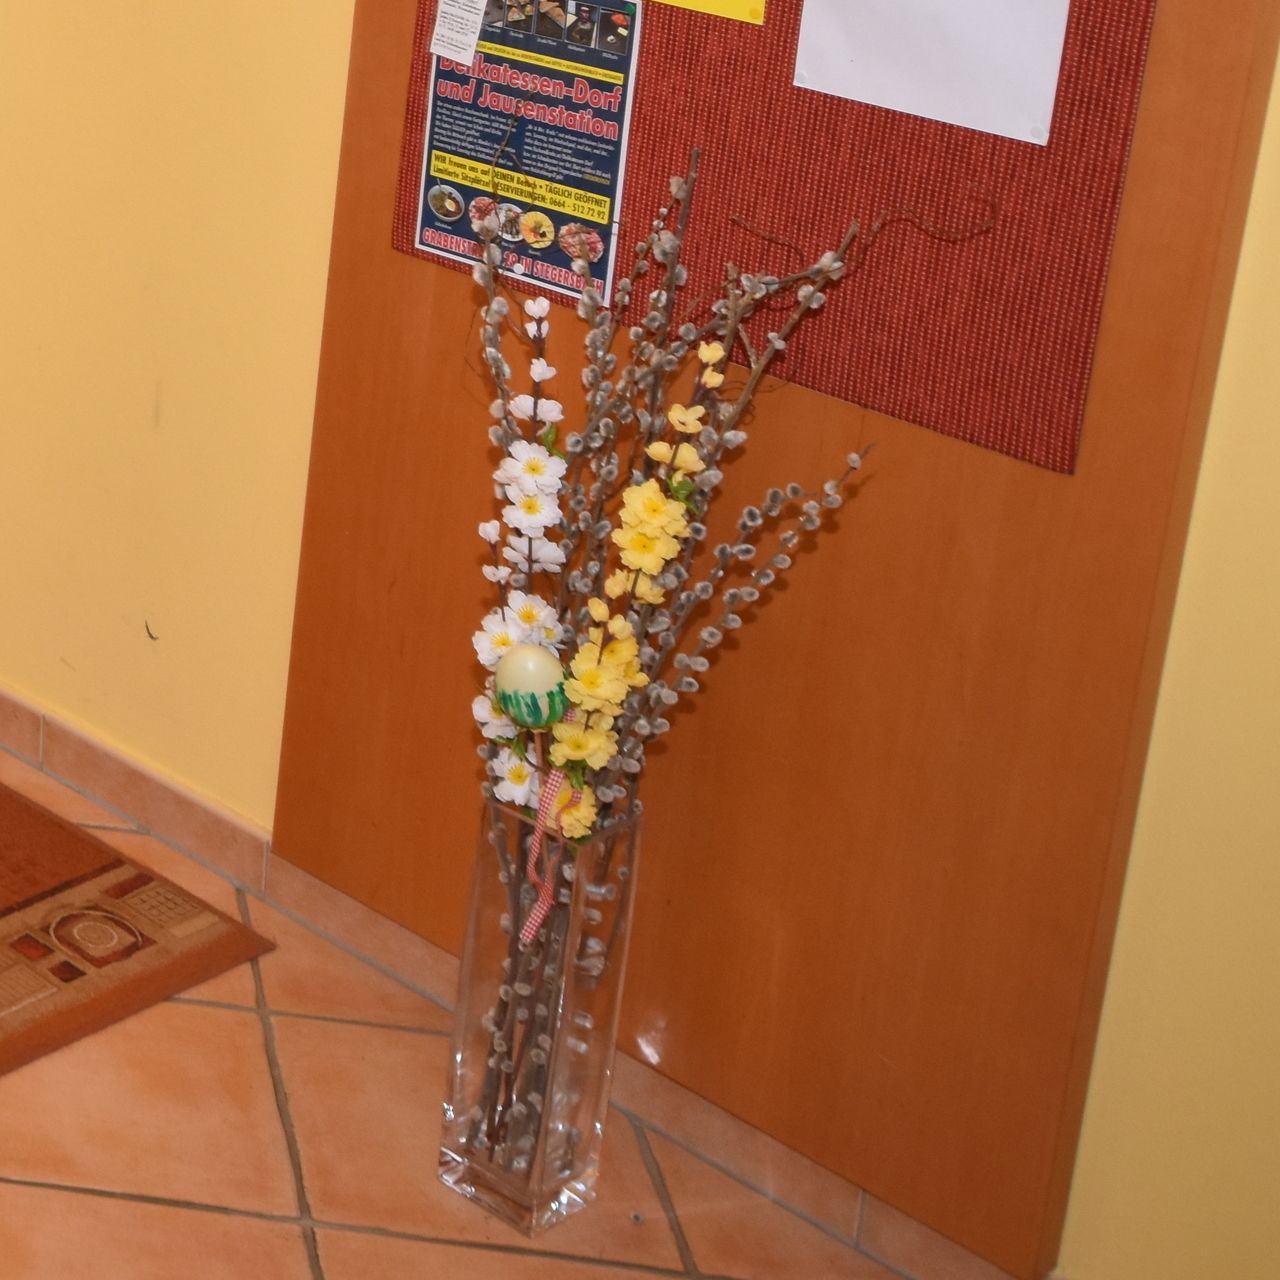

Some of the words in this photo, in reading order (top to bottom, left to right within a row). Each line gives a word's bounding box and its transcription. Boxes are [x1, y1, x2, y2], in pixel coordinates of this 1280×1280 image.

[436, 78, 477, 103] und
[477, 82, 620, 141] Jausenstation
[433, 164, 460, 180] Limitierte
[549, 197, 566, 209] 0664
[572, 203, 585, 214] 512
[586, 206, 596, 217] 72
[596, 209, 606, 220] 92
[434, 153, 447, 164] WIR
[448, 157, 468, 170] freuen
[480, 167, 490, 177] auf
[493, 169, 516, 183] DEINEN
[545, 182, 573, 199] TÄGLICH
[574, 190, 608, 209] GEÖFFNET
[520, 255, 533, 274] IN
[533, 260, 605, 297] STEGERSBH
